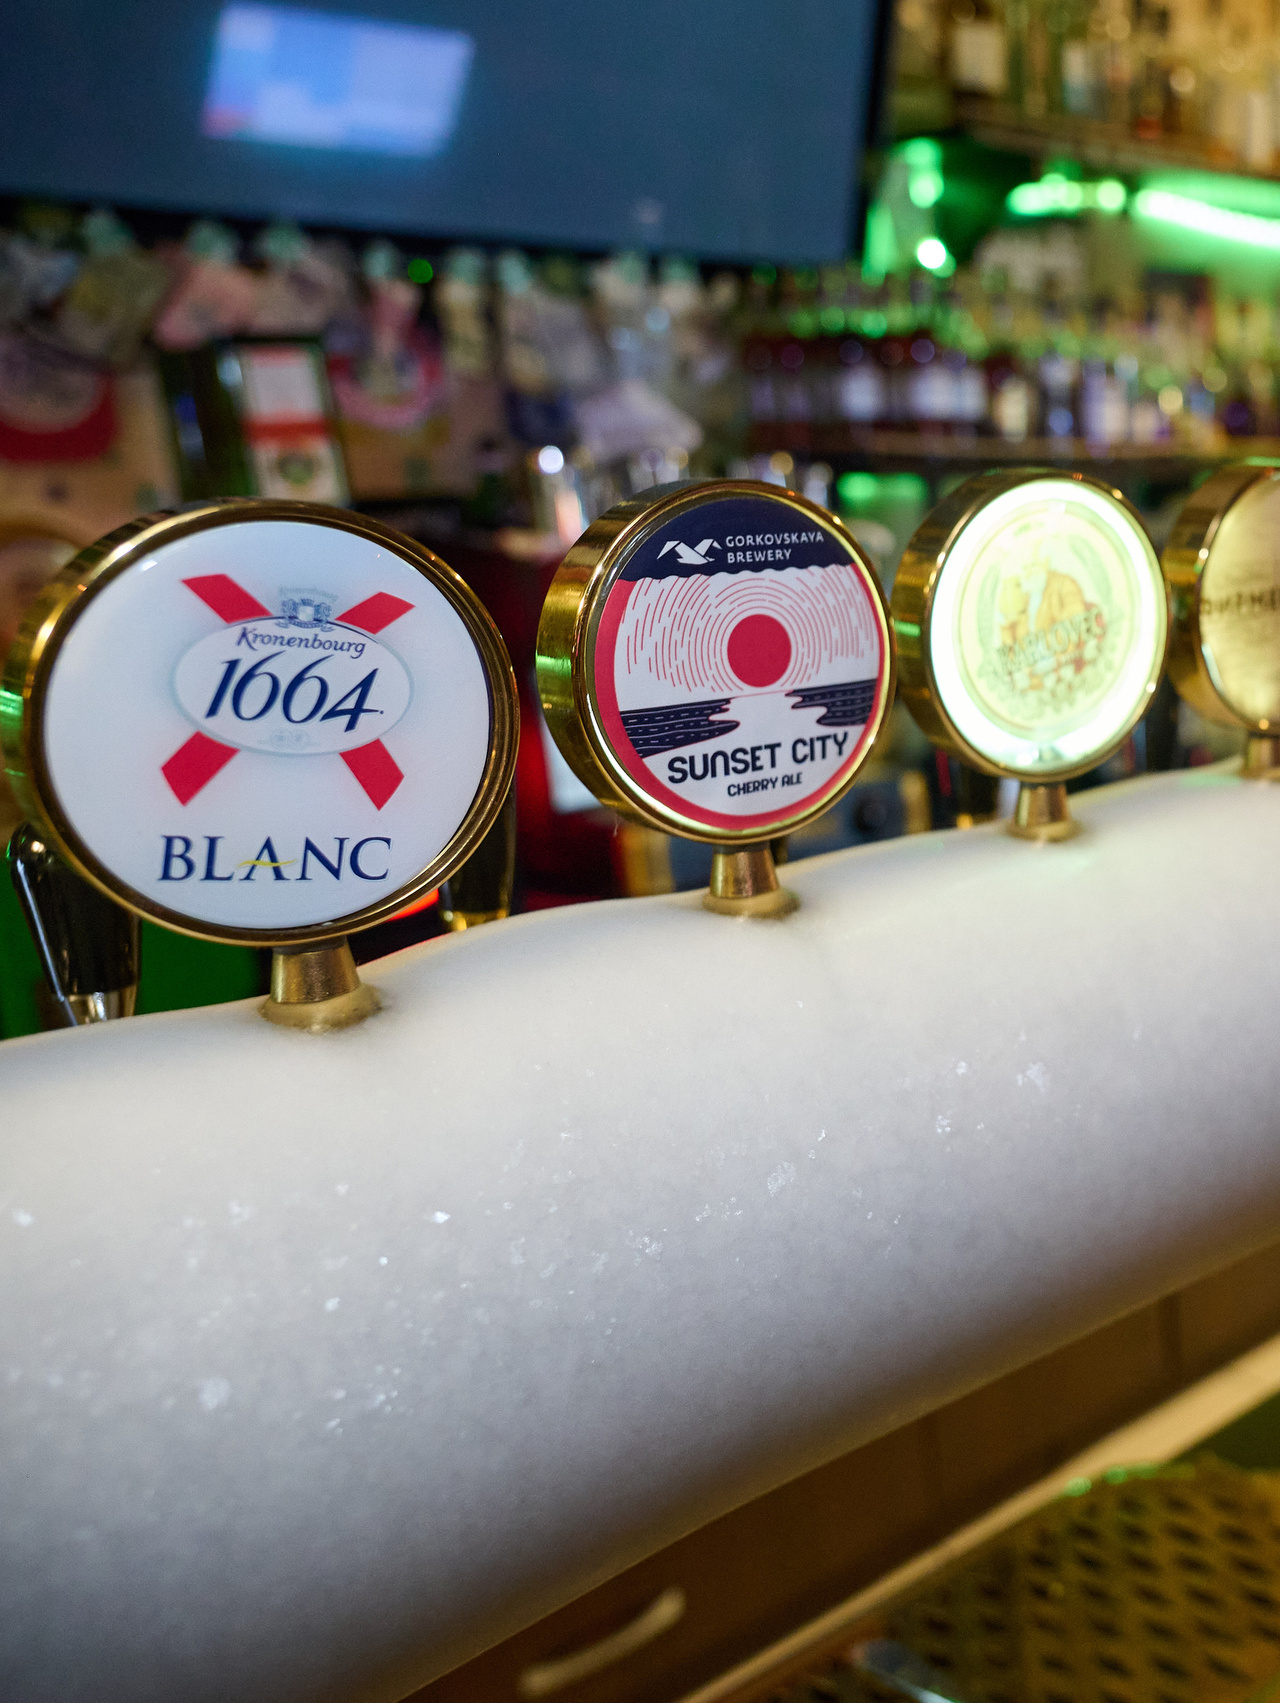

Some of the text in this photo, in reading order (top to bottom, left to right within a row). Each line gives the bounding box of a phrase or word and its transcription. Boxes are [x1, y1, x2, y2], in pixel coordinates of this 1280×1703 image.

[725, 531, 825, 548] GORKOVSKAYA
[727, 549, 792, 564] BREWERY
[235, 626, 366, 660] Kronenbourg
[205, 651, 380, 732] 1664
[667, 731, 848, 784] SUNSET CITY
[727, 772, 803, 797] CHERRY ALE
[158, 835, 392, 882] BLANC
